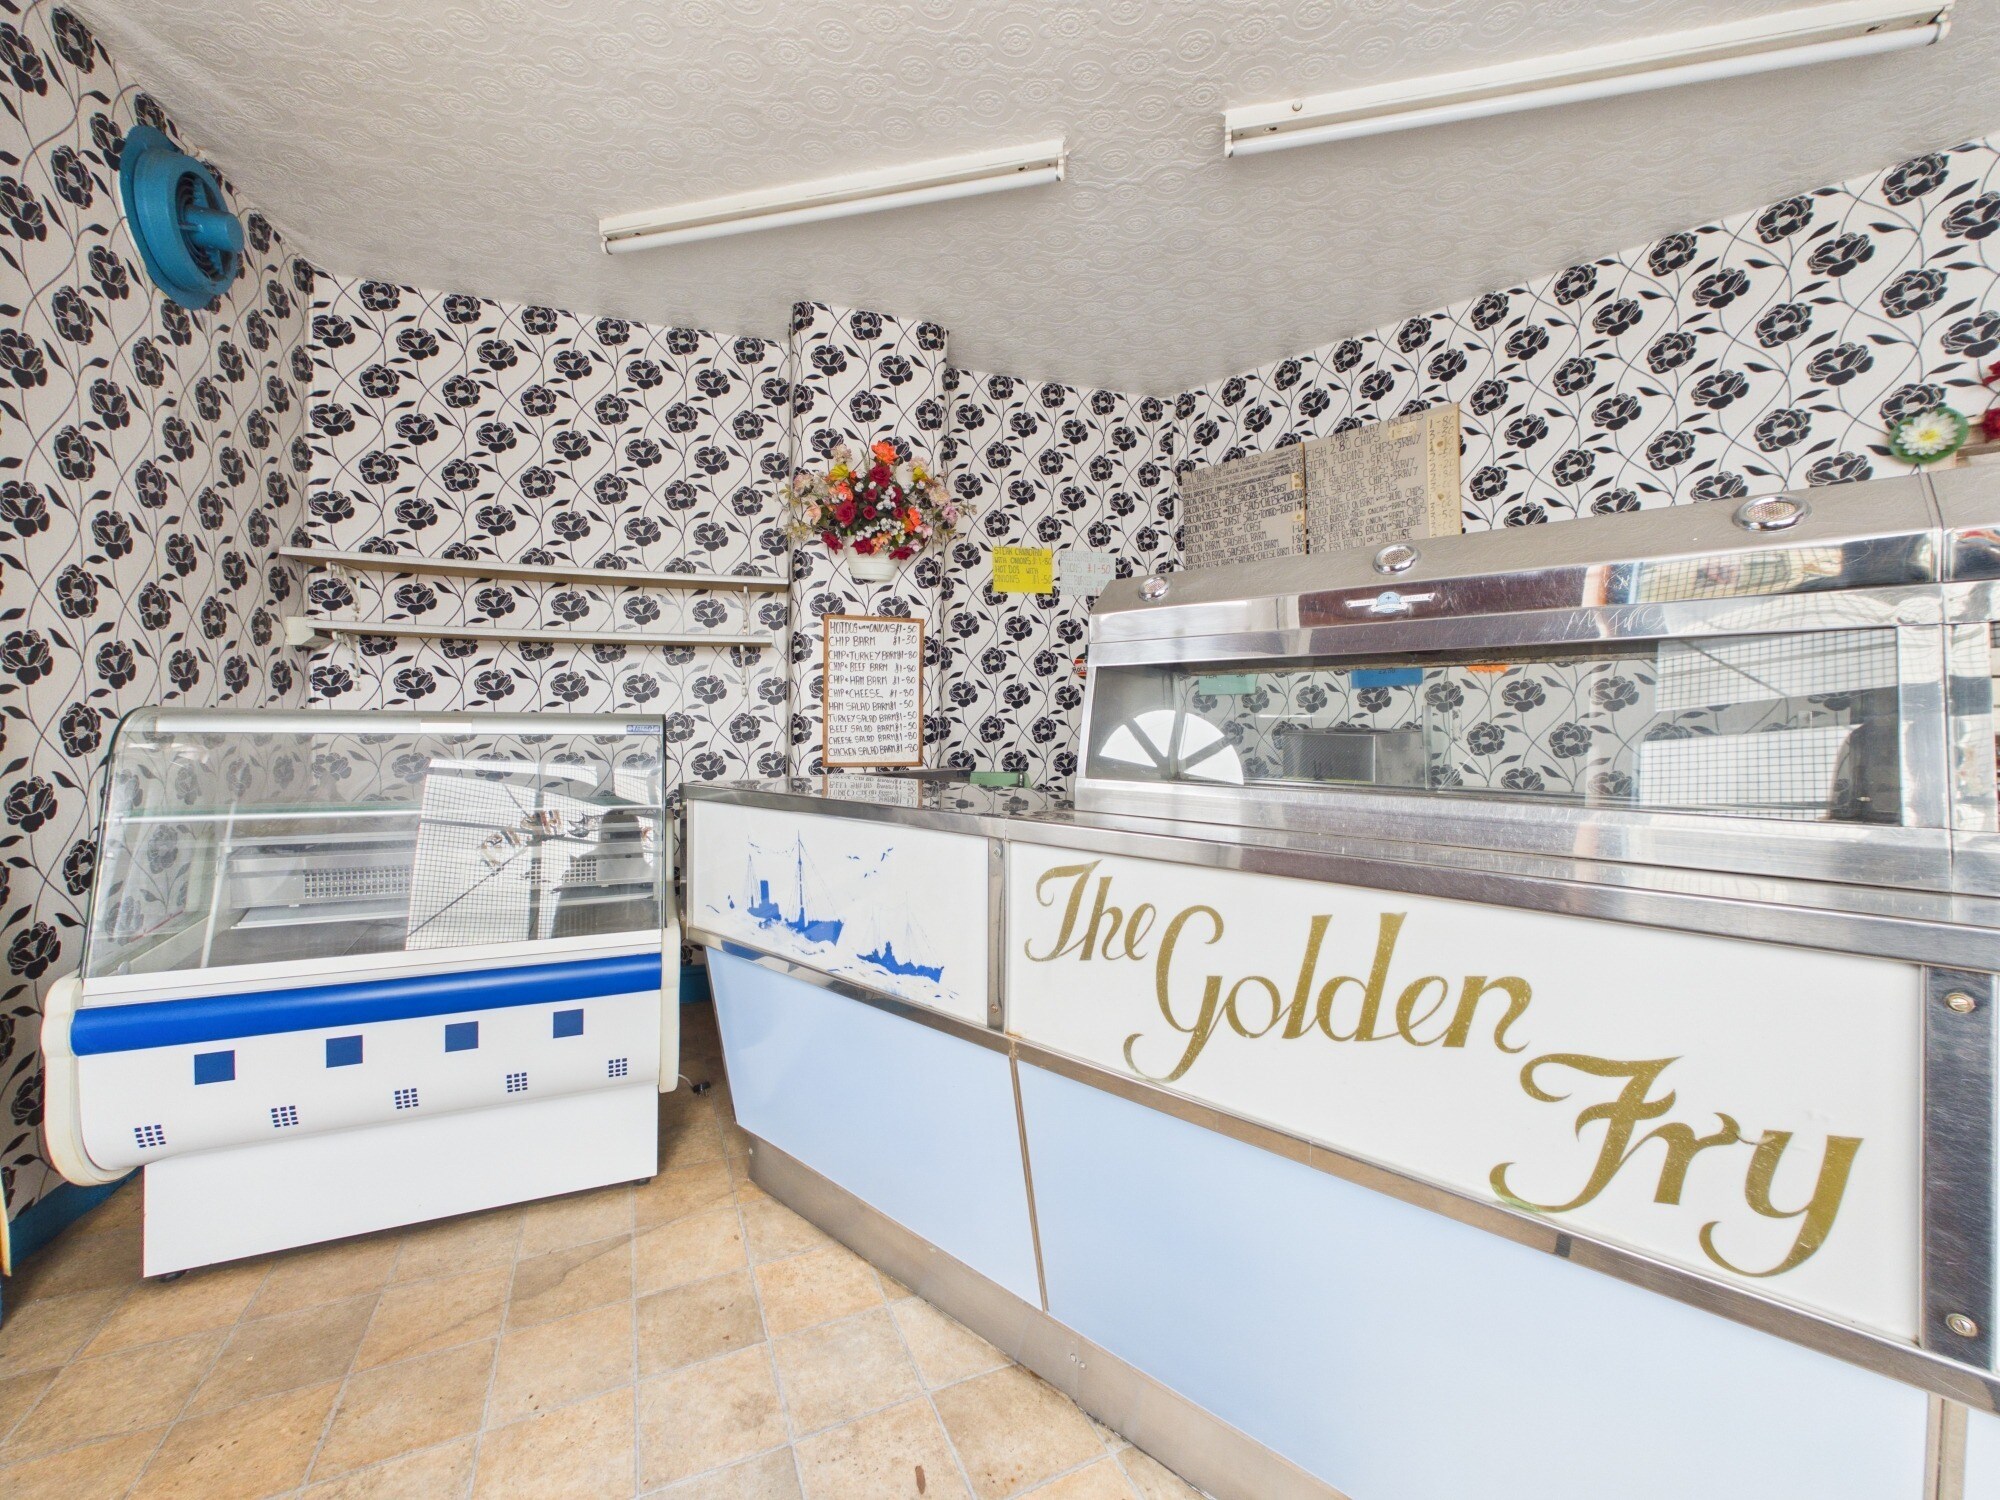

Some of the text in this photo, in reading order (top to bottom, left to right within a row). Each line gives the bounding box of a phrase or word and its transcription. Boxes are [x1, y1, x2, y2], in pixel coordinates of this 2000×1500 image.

[1388, 413, 1423, 428] PRICES
[1305, 447, 1326, 458] FISH
[1354, 432, 1380, 446] CHIPS
[1305, 459, 1327, 471] STEAK
[1369, 441, 1393, 454] CHIPS
[1323, 466, 1336, 477] PIE
[1341, 459, 1364, 473] CHIPS
[1363, 466, 1385, 477] CHIPS
[1369, 473, 1389, 485] CHIPS
[1373, 480, 1397, 494] PEAS
[995, 565, 1007, 573] HOT
[829, 636, 850, 646] CHIP
[853, 636, 876, 646] BARM
[828, 650, 846, 660] CHIP
[849, 651, 881, 660] TURKEY
[882, 651, 898, 660] BARM
[849, 663, 865, 672] BEEF
[870, 663, 887, 672] BARM
[849, 676, 864, 685] HAM
[867, 676, 887, 685] BARM
[828, 689, 844, 697] CHIP
[849, 689, 883, 699] CHEESE
[829, 702, 843, 711] HAM
[845, 702, 870, 711] SALAD
[872, 702, 890, 711] BARM
[828, 714, 855, 723] TURKEY
[856, 714, 877, 723] SALAD
[879, 713, 896, 722] BARM
[829, 725, 848, 733] BEEF
[851, 725, 872, 733] SALAD
[877, 725, 895, 733] BARM
[829, 737, 853, 745] CHEESE
[855, 735, 874, 743] SALAD
[878, 734, 896, 742] BARM
[828, 748, 856, 756] CHICKEN
[858, 746, 879, 755] SALAD
[880, 745, 895, 754] BARM
[1024, 859, 1532, 1083] The Golden
[1489, 1052, 1864, 1278] Fry
